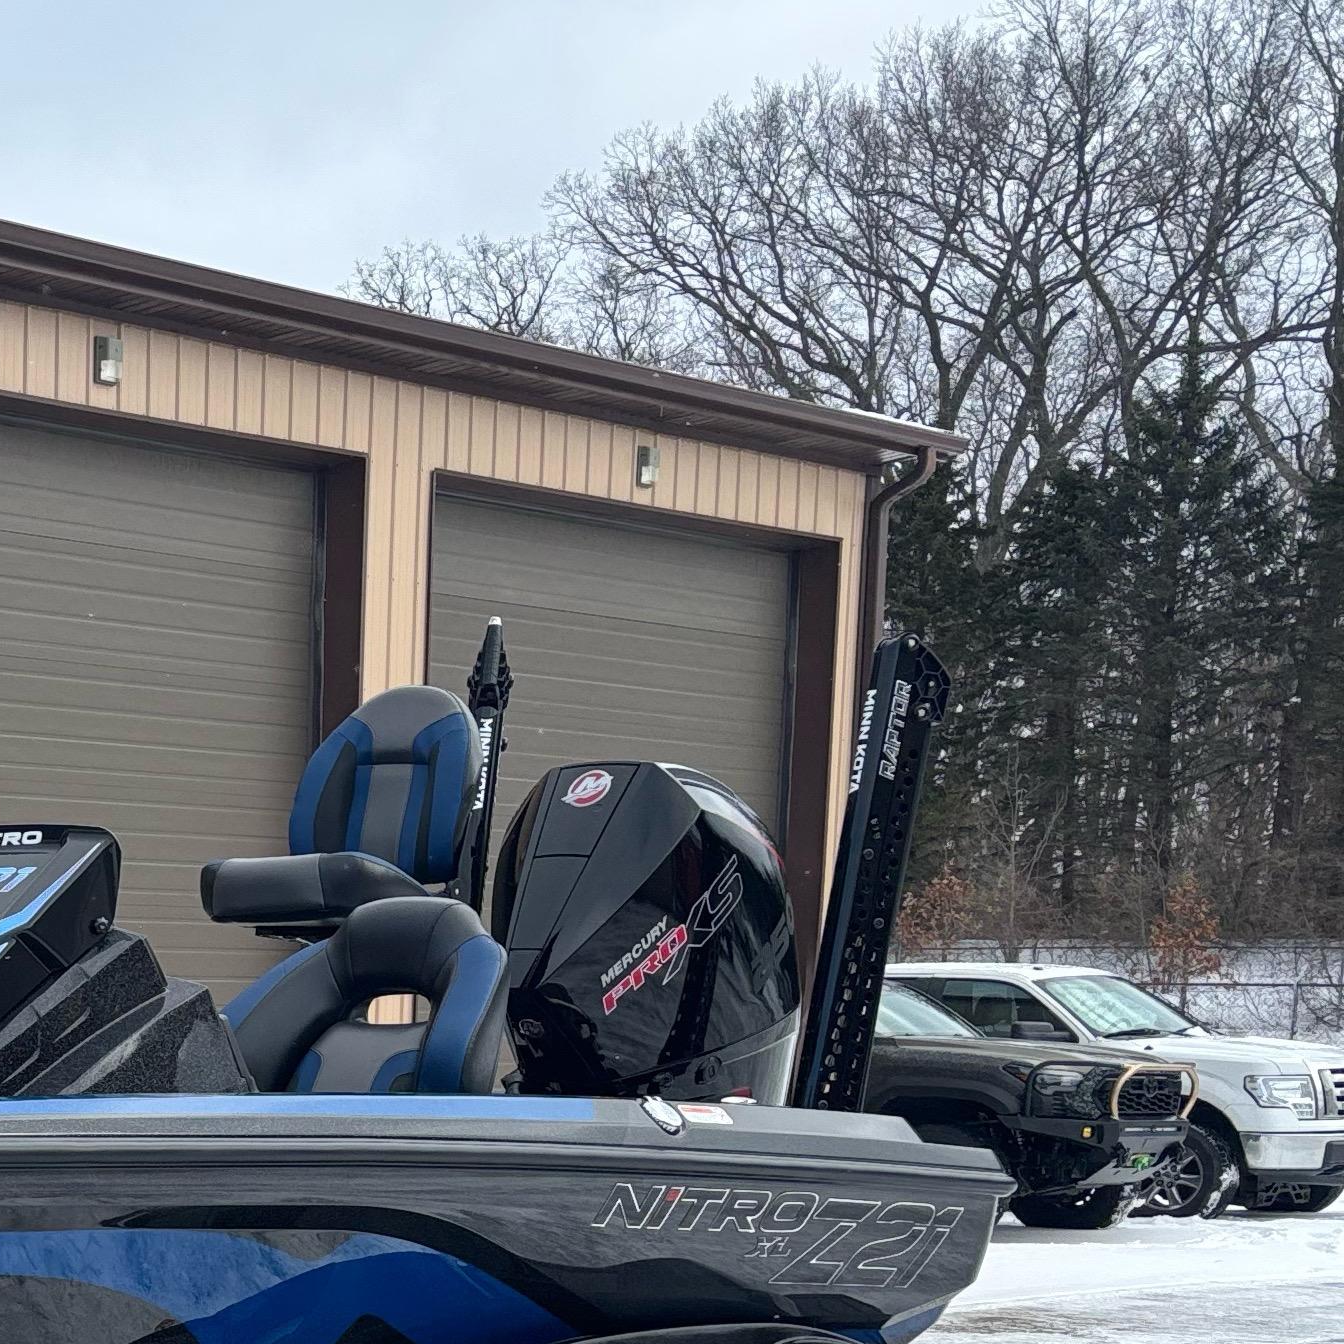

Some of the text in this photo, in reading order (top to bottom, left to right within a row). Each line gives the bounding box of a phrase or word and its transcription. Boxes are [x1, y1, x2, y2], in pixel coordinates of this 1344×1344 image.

[848, 688, 878, 795] MINN KOTA
[878, 679, 913, 781] RAPTOR
[600, 914, 669, 988] MERCURY
[602, 853, 744, 1016] PRO XS
[743, 1236, 792, 1258] XL
[767, 1198, 965, 1289] Z21
